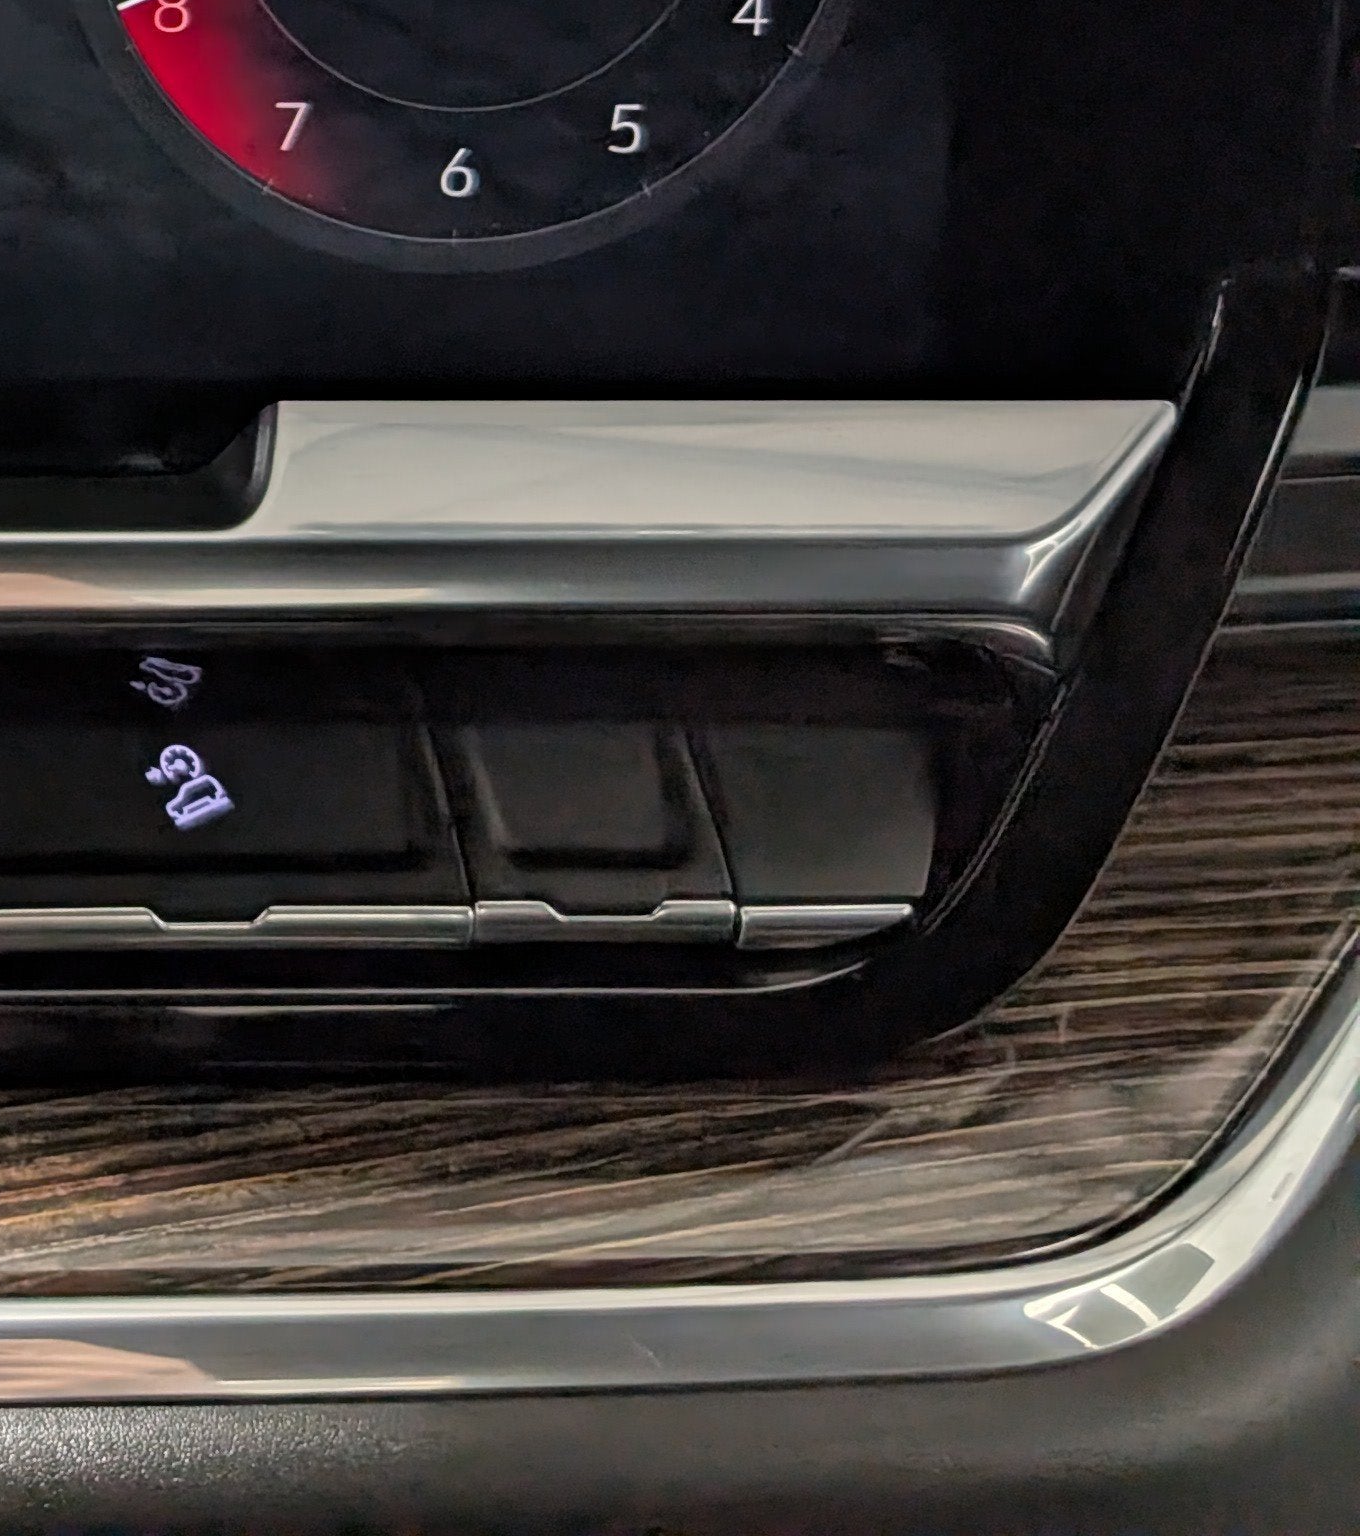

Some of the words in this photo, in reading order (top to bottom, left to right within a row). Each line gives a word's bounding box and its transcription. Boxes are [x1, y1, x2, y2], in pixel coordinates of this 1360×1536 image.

[275, 101, 312, 151] 7
[608, 103, 644, 154] 5
[440, 147, 480, 198] 6
